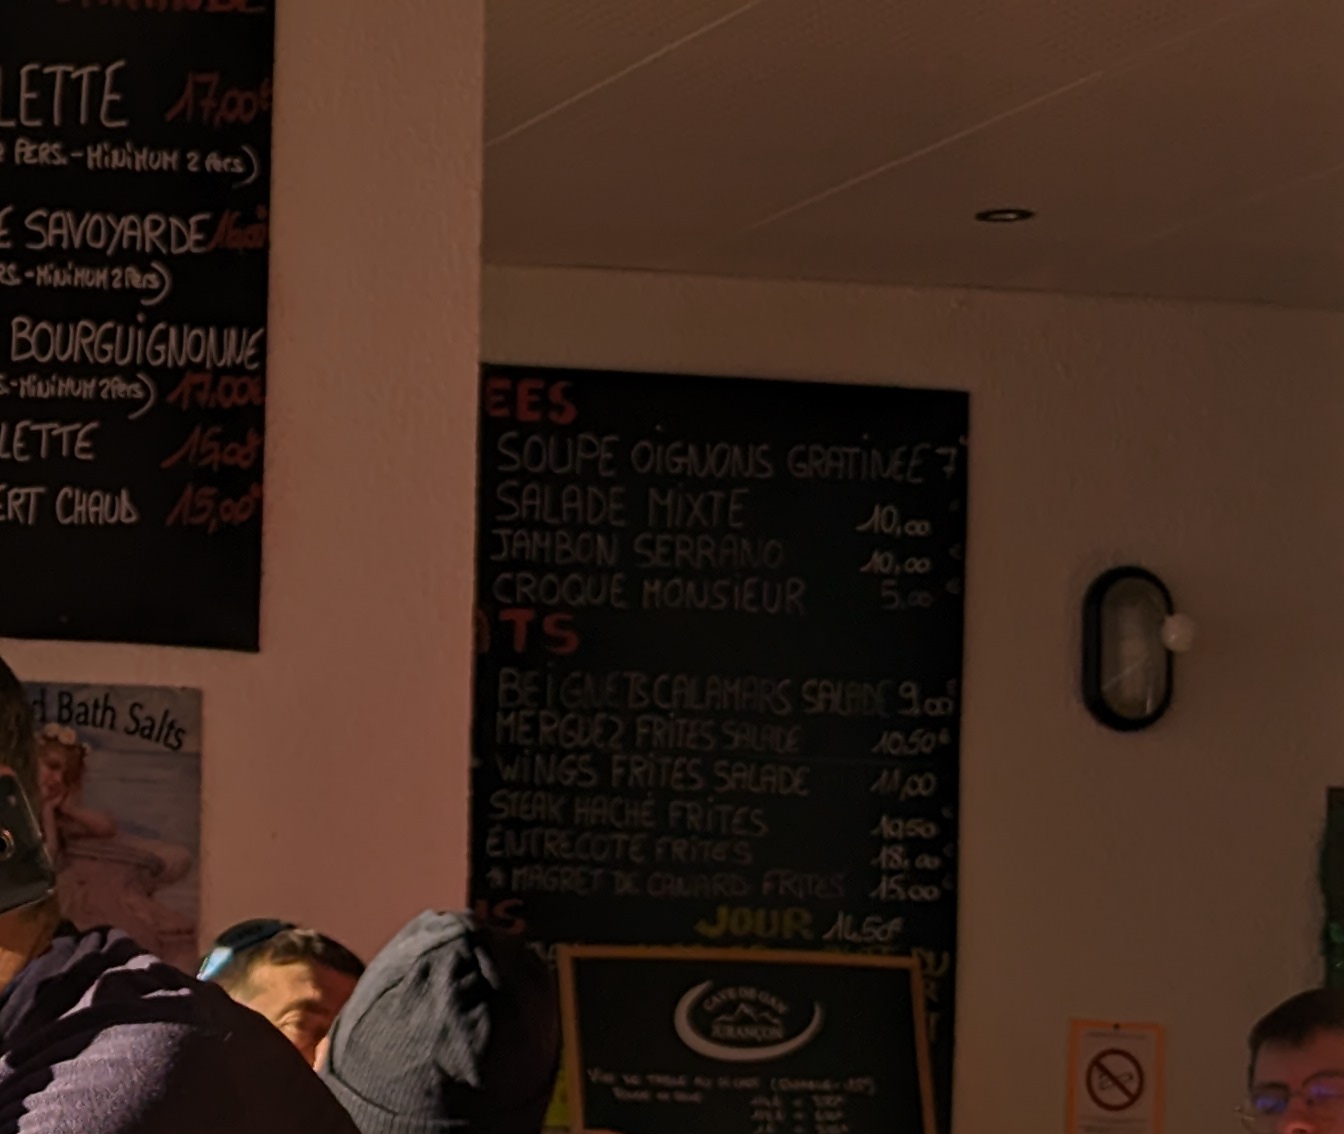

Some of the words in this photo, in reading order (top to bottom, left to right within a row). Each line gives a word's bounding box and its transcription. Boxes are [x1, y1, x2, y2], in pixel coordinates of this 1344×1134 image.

[24, 209, 211, 254] SAVOYARDE
[12, 313, 264, 370] BOURGUIGNONNE
[496, 430, 621, 478] SOUPE
[630, 424, 774, 480] OIGNONS
[55, 488, 140, 526] CHAUD
[495, 479, 626, 527] SALADE
[648, 483, 751, 529] MIXTE
[489, 528, 619, 567] JAMBON
[632, 532, 785, 569] SERRANO
[492, 571, 628, 608] CROQUE
[642, 573, 807, 616] MONSIEUR
[57, 691, 116, 732] Bath
[124, 703, 187, 751] Salts
[494, 749, 598, 788] WINGS
[713, 760, 811, 797] SALADE
[488, 788, 566, 823] STEAK
[694, 901, 814, 939] JOUR
